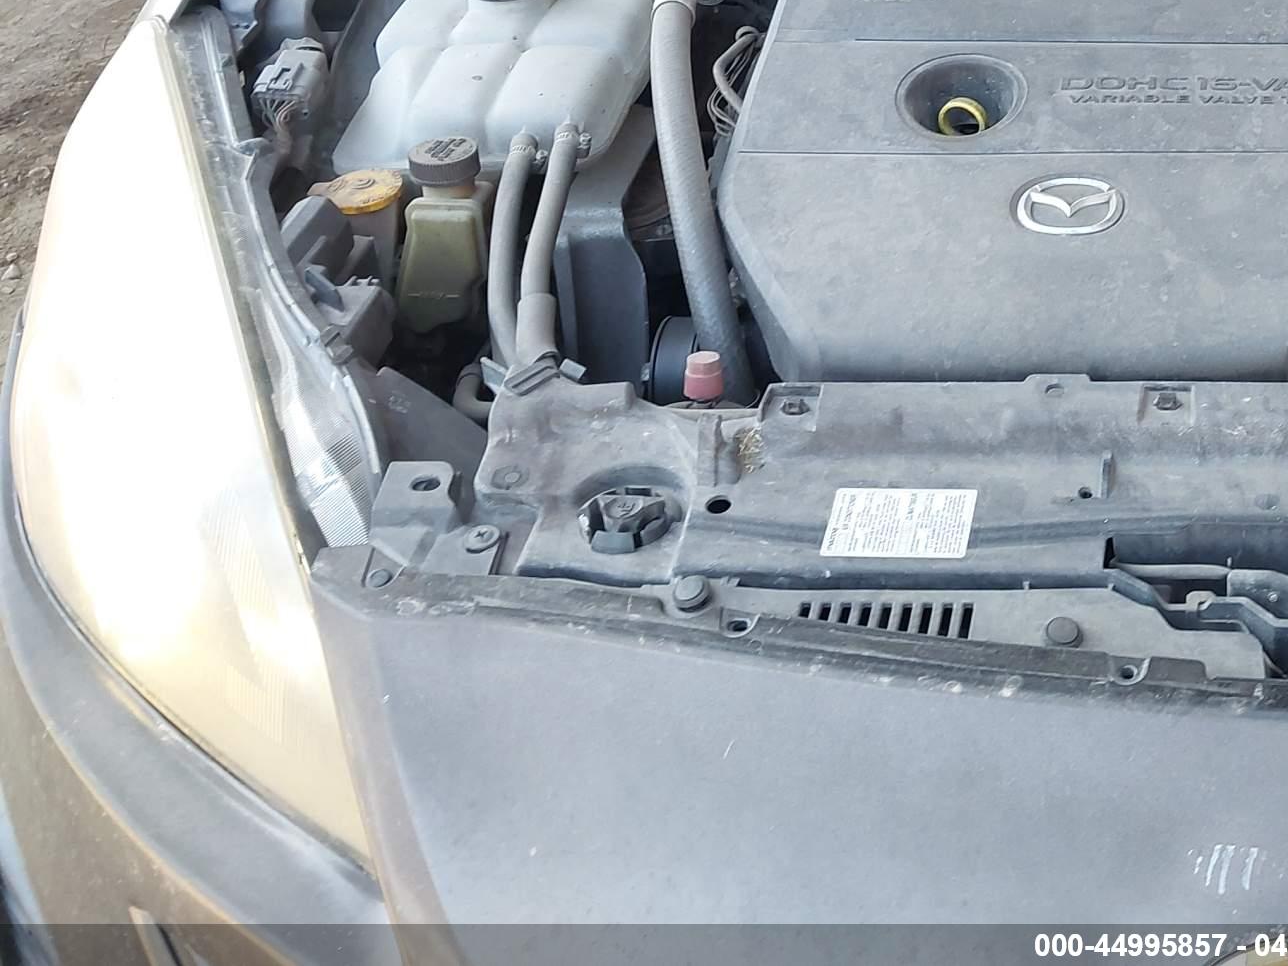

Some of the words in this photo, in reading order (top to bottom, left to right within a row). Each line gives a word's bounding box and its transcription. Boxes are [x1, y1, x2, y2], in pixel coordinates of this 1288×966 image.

[1061, 76, 1188, 91] DOHC
[1069, 94, 1191, 105] VARIABLE
[1198, 94, 1274, 105] VALVE
